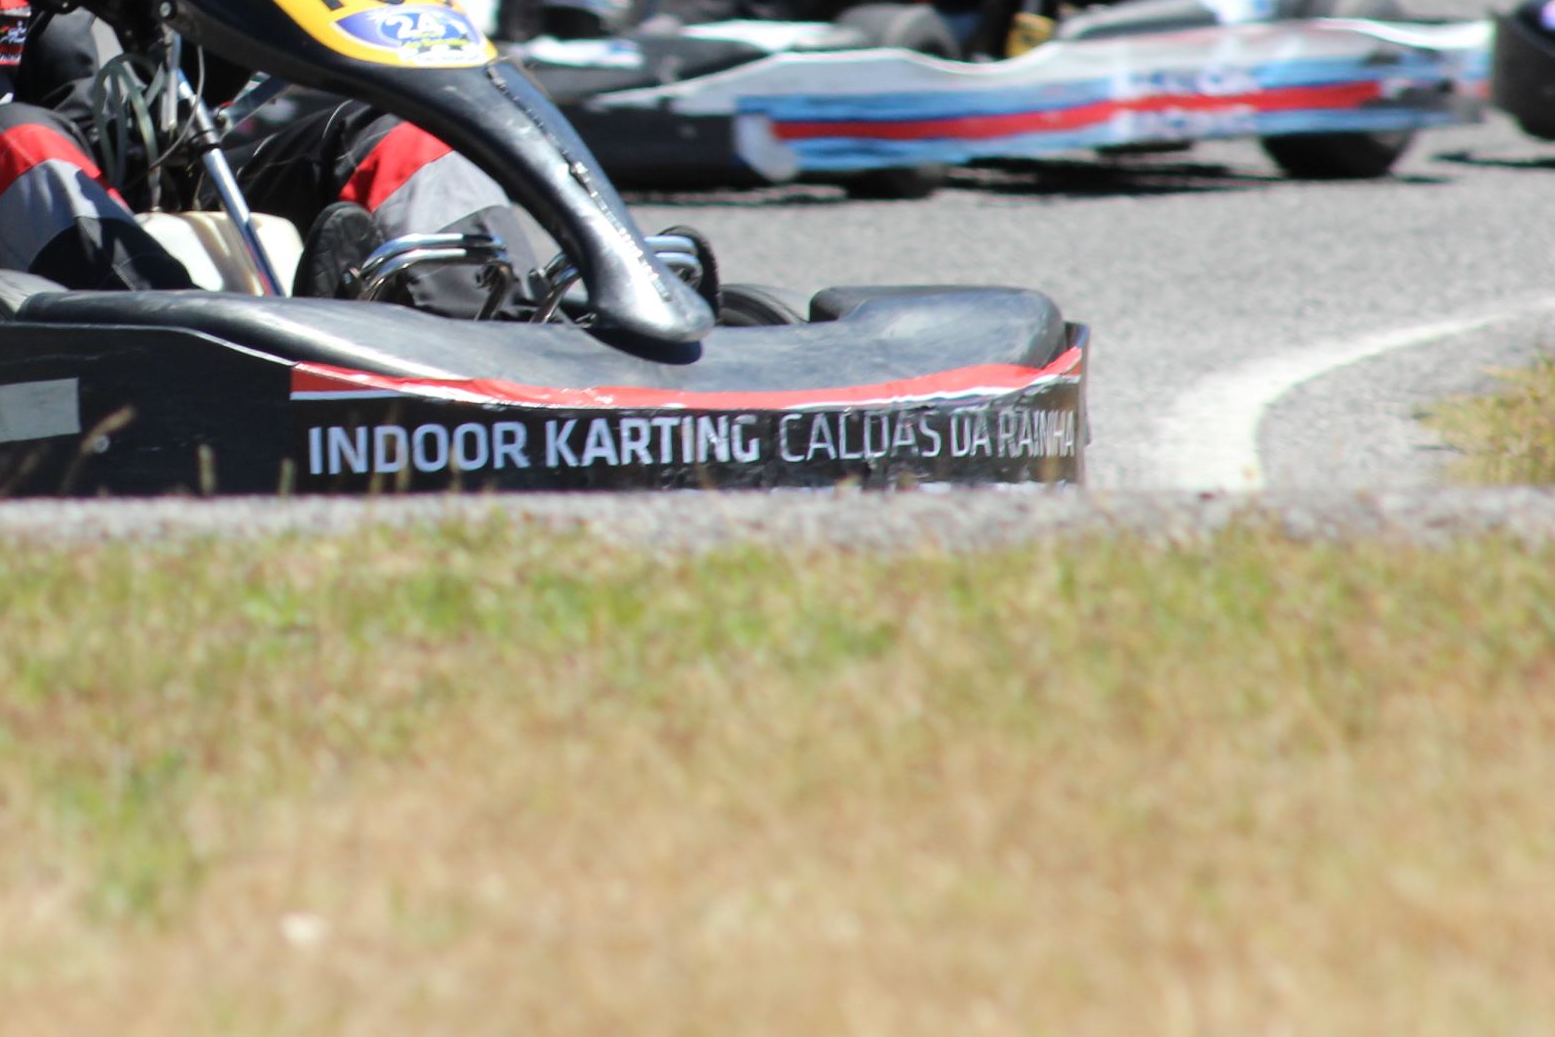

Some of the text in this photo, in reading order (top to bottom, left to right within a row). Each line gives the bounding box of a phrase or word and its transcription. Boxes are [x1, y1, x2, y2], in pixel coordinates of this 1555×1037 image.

[308, 421, 531, 476] INDOOR
[545, 414, 761, 468] KARTING
[779, 412, 941, 462] CALDAS
[950, 412, 992, 458] DA
